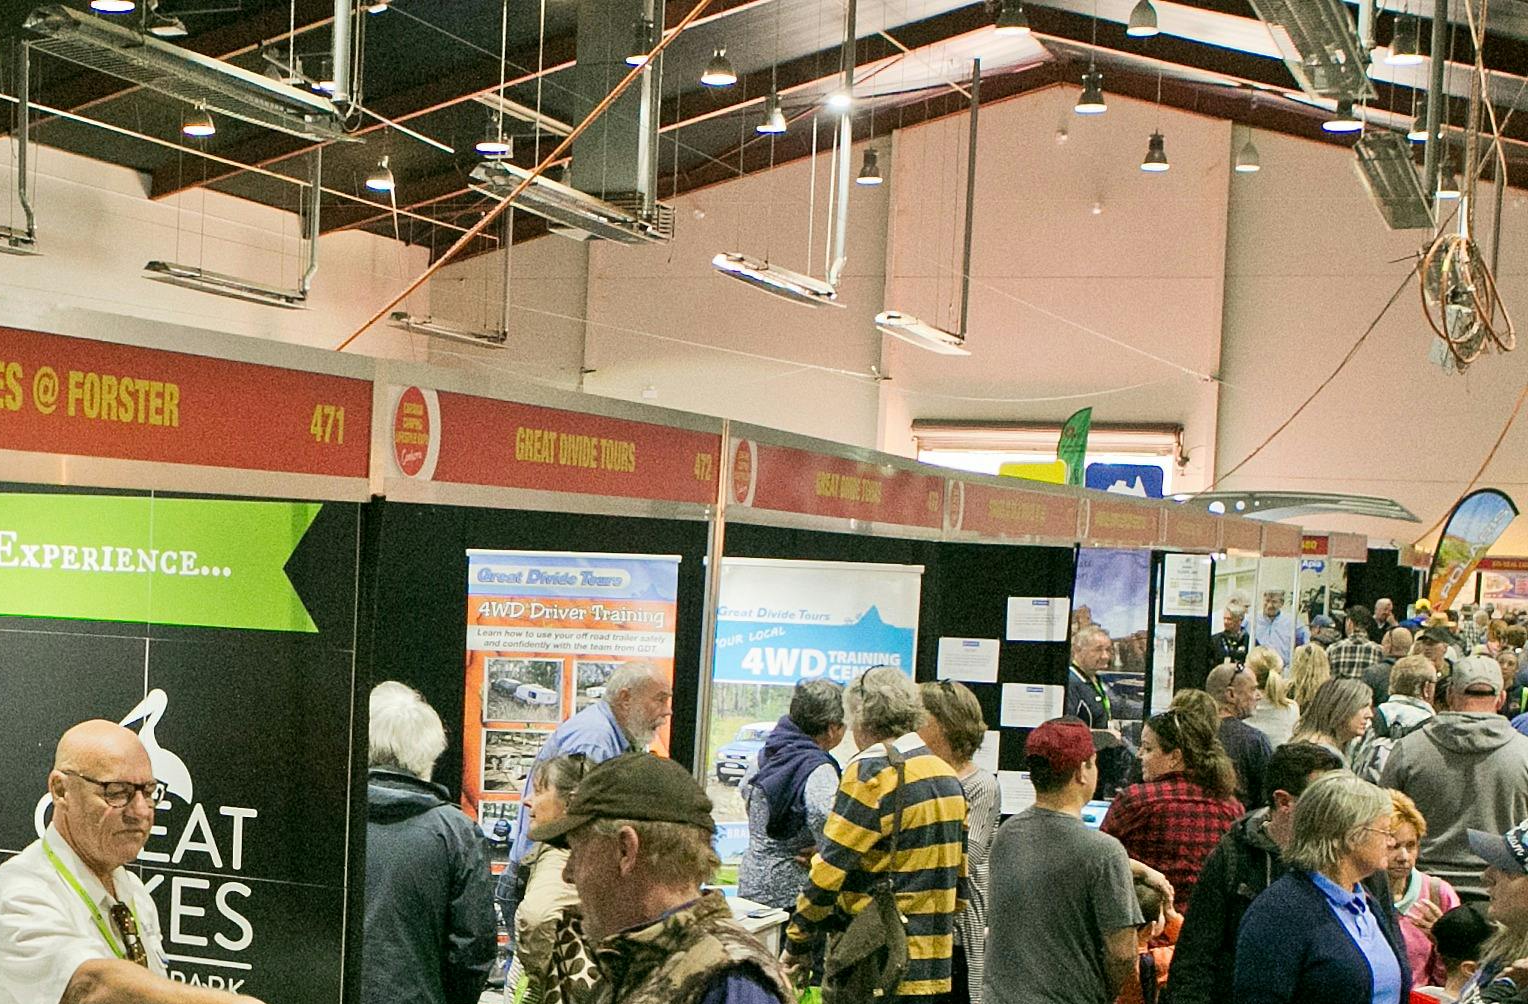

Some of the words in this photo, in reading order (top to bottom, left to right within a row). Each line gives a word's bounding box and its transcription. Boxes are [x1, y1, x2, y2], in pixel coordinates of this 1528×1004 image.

[32, 366, 60, 415] @
[66, 370, 180, 427] FORSTER
[310, 403, 345, 445] 471
[515, 427, 558, 464] GREAT
[600, 438, 636, 473] TOURS
[476, 567, 523, 584] Great
[526, 569, 578, 586] Divide
[580, 571, 623, 587] Tours
[478, 601, 525, 618] 4WD
[529, 602, 587, 621] Driver
[591, 604, 665, 628] Training
[717, 606, 753, 618] Great
[757, 607, 796, 620] Divide
[799, 609, 831, 621] Tours
[477, 628, 502, 637] Learn
[504, 629, 523, 637] how
[537, 631, 552, 639] use
[554, 632, 574, 641] your
[484, 640, 501, 648] and
[503, 640, 551, 650] confidently
[553, 641, 572, 649] with
[574, 642, 587, 650] the
[590, 643, 612, 651] team
[748, 627, 787, 643] LOCAL
[740, 647, 828, 678] 4WD
[827, 650, 902, 666] TRAINING
